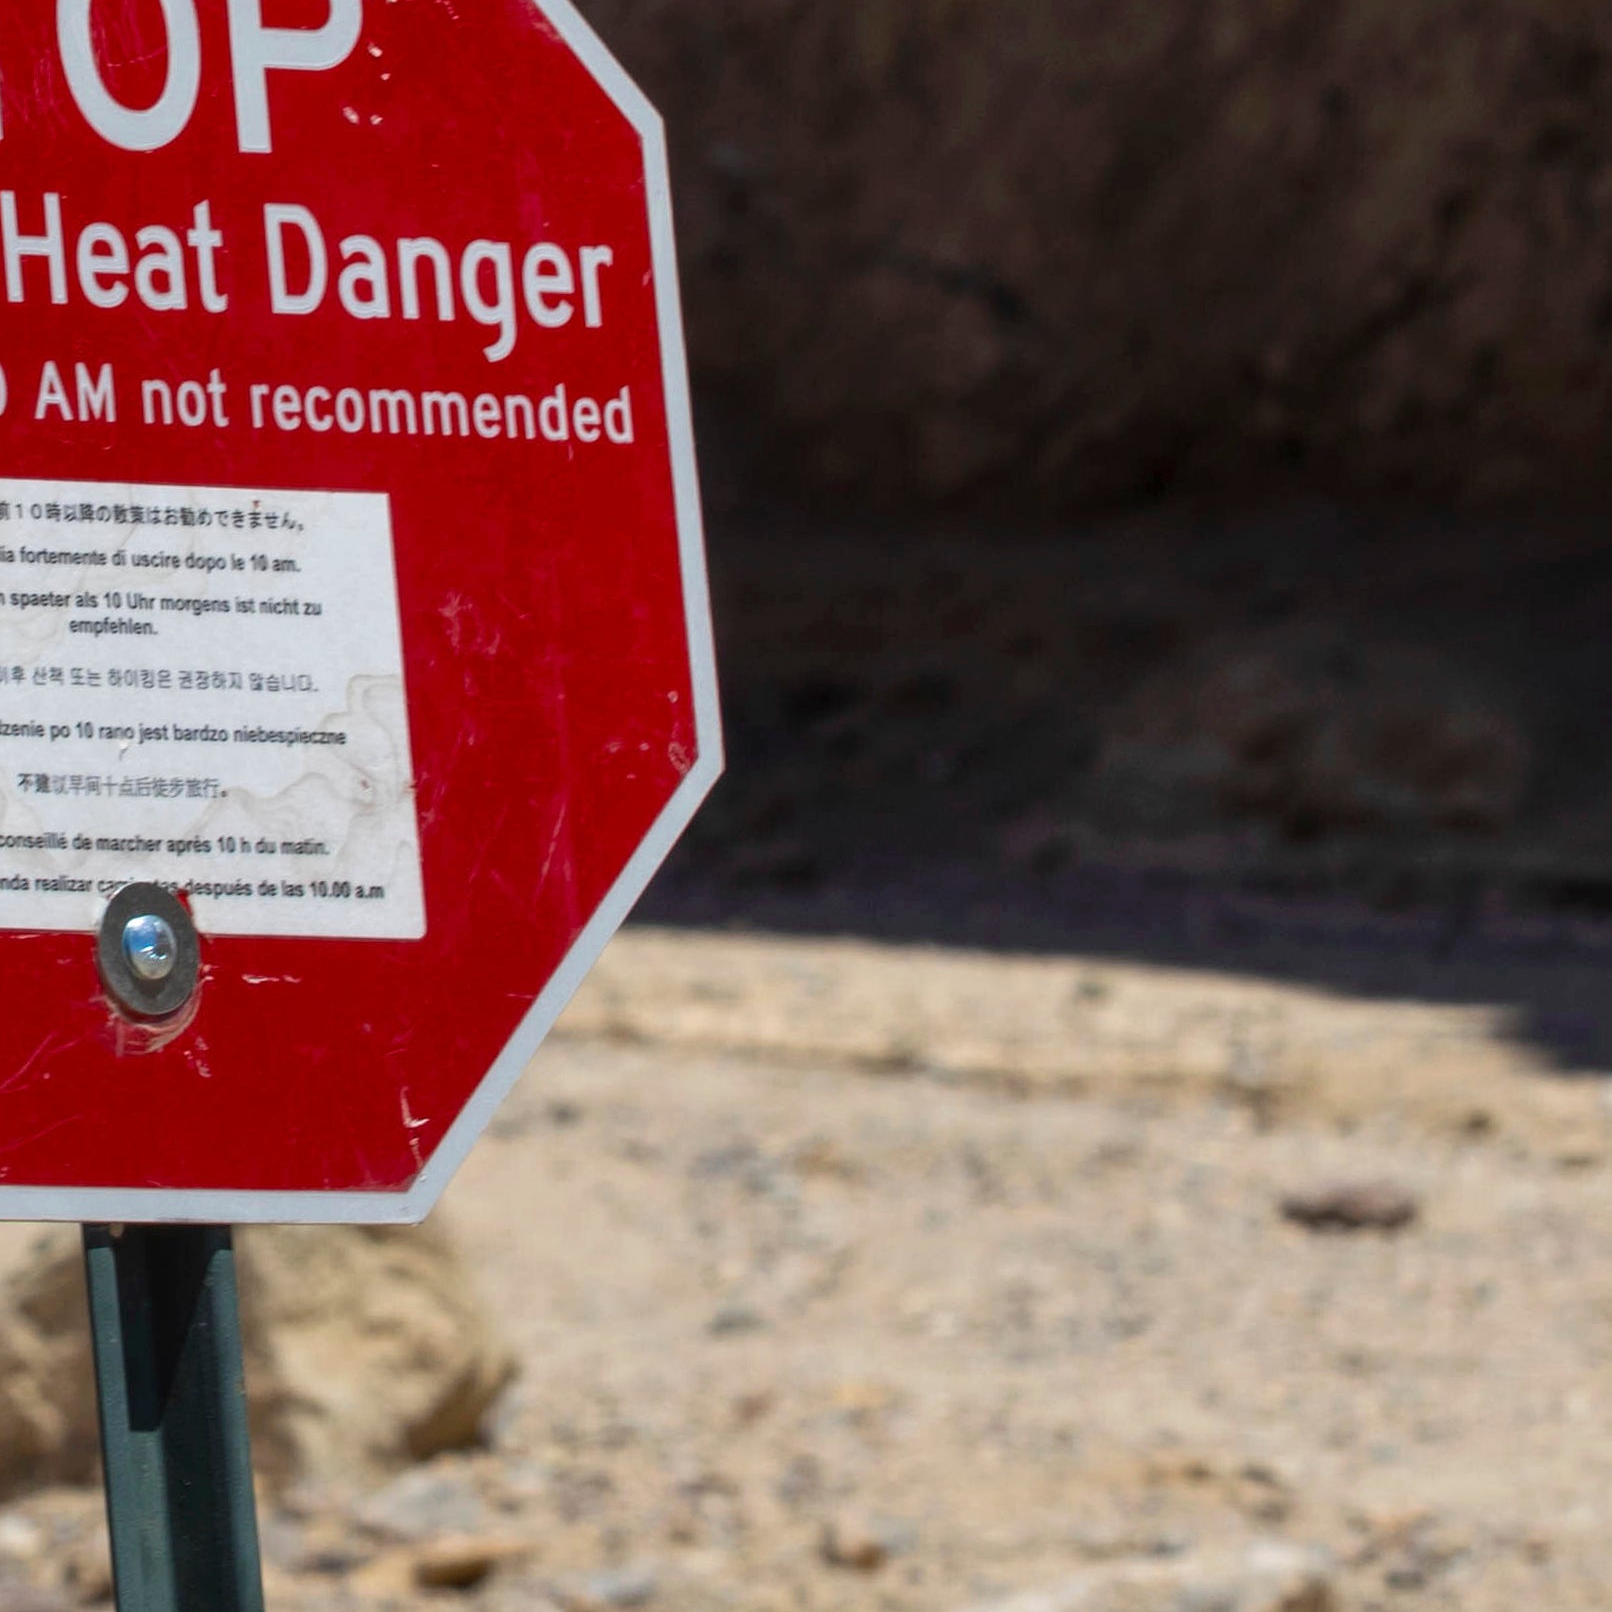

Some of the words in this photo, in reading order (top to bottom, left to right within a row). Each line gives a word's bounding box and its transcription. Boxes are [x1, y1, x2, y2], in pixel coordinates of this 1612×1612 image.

[0, 189, 229, 315] Heat
[264, 203, 614, 362] Danger
[35, 362, 117, 425] AM
[141, 370, 229, 429] not
[250, 382, 636, 446] recommended
[20, 546, 107, 566] fortemente
[111, 549, 126, 566] di
[131, 550, 180, 569] uscire
[184, 552, 227, 573] dopo
[230, 554, 246, 571] le
[250, 554, 269, 571] 10
[272, 557, 302, 573] am.
[9, 590, 71, 610] spaeter
[75, 590, 98, 608] als
[103, 591, 122, 609] 10
[126, 593, 155, 610] Uhr
[160, 597, 231, 616] morgens
[235, 595, 255, 614] ist
[259, 595, 301, 615] nicht
[303, 601, 322, 616] zu
[69, 618, 158, 638] empfehlen.
[69, 667, 102, 687] 또는
[107, 668, 172, 689] 하이킹은
[178, 669, 243, 690] 권장하지
[50, 724, 71, 742] po
[75, 721, 94, 738] 10
[98, 726, 133, 740] rano
[138, 723, 168, 744] jest
[172, 724, 228, 743] bardzo
[72, 833, 92, 850] de
[96, 834, 162, 853] marcher
[218, 836, 235, 854] 10
[240, 836, 251, 854] h
[255, 837, 277, 855] du
[280, 838, 330, 856] matin.
[34, 874, 93, 893] realizar
[184, 877, 254, 899] después
[258, 879, 278, 896] de
[281, 880, 305, 897] las
[309, 880, 351, 898] 10.00
